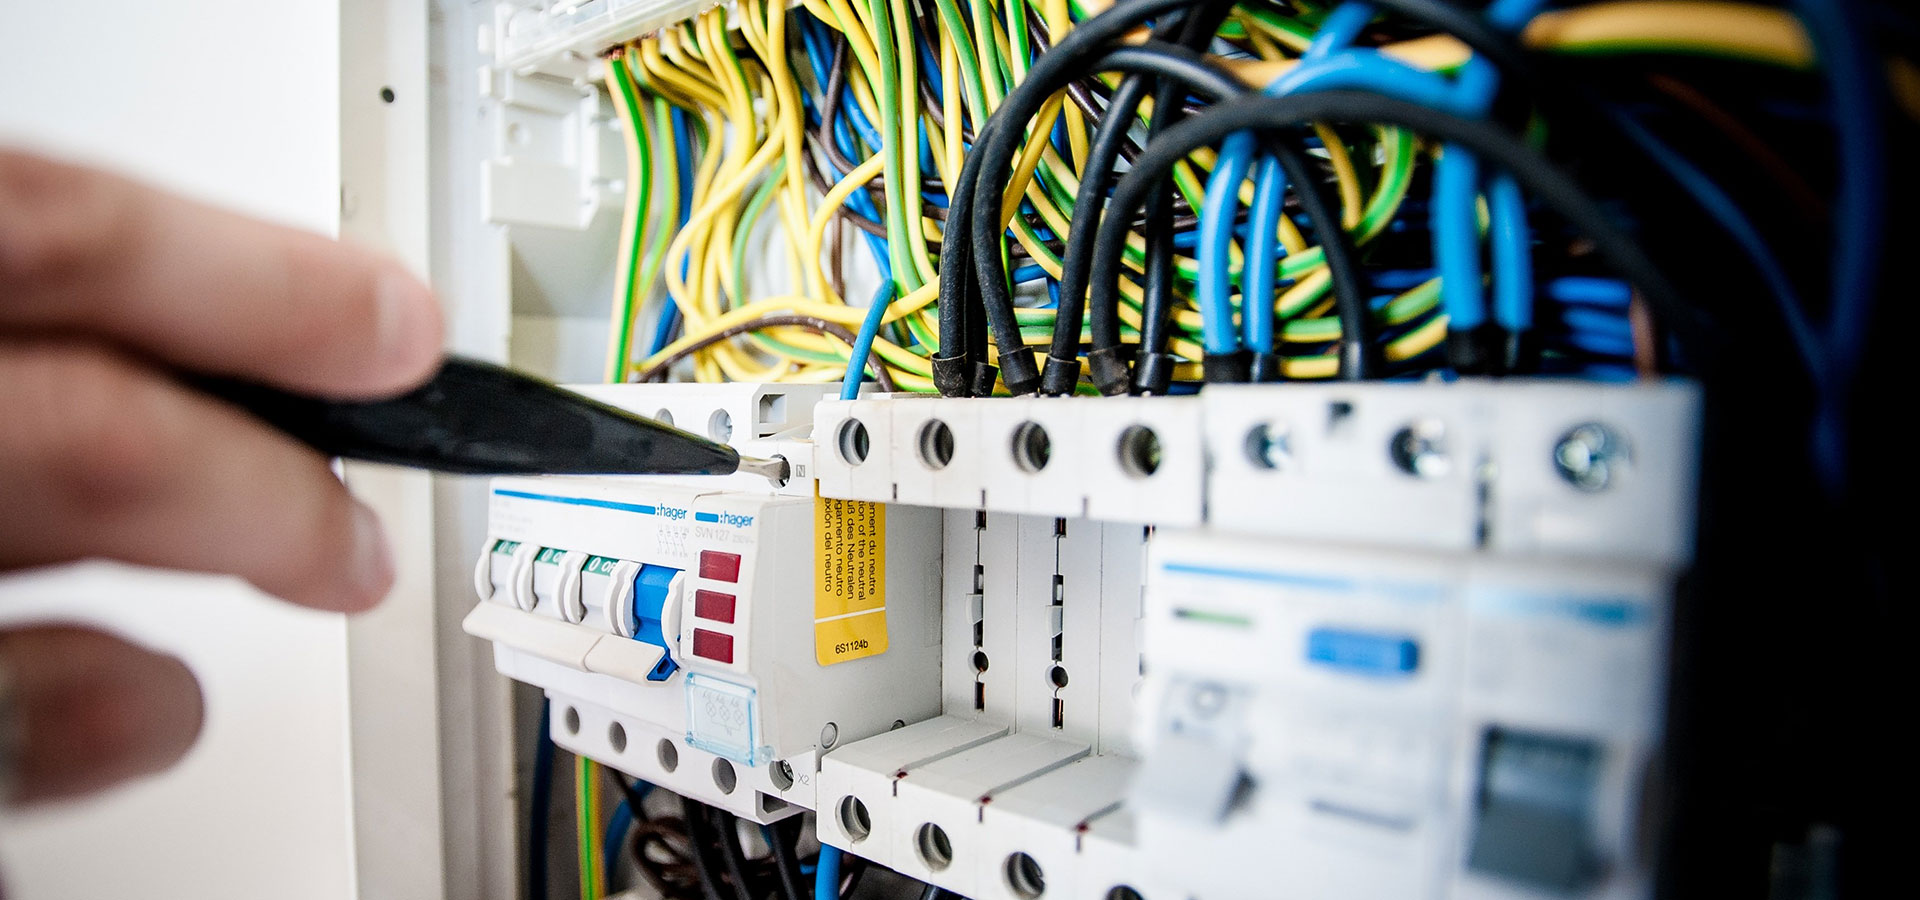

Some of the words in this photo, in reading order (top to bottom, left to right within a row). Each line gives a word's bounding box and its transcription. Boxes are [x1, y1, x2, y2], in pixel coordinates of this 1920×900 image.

[694, 526, 713, 540] SVN
[715, 529, 730, 542] 127
[847, 518, 855, 540] des
[858, 525, 866, 536] of
[824, 532, 833, 550] del
[858, 539, 866, 558] the
[868, 540, 876, 555] du
[824, 554, 832, 593] neutro
[847, 543, 855, 600] Neutralen
[868, 559, 876, 595] neutre
[858, 561, 866, 601] neutral
[688, 591, 693, 602] 2
[835, 639, 869, 654] 6S1124b
[797, 773, 809, 786] X2
